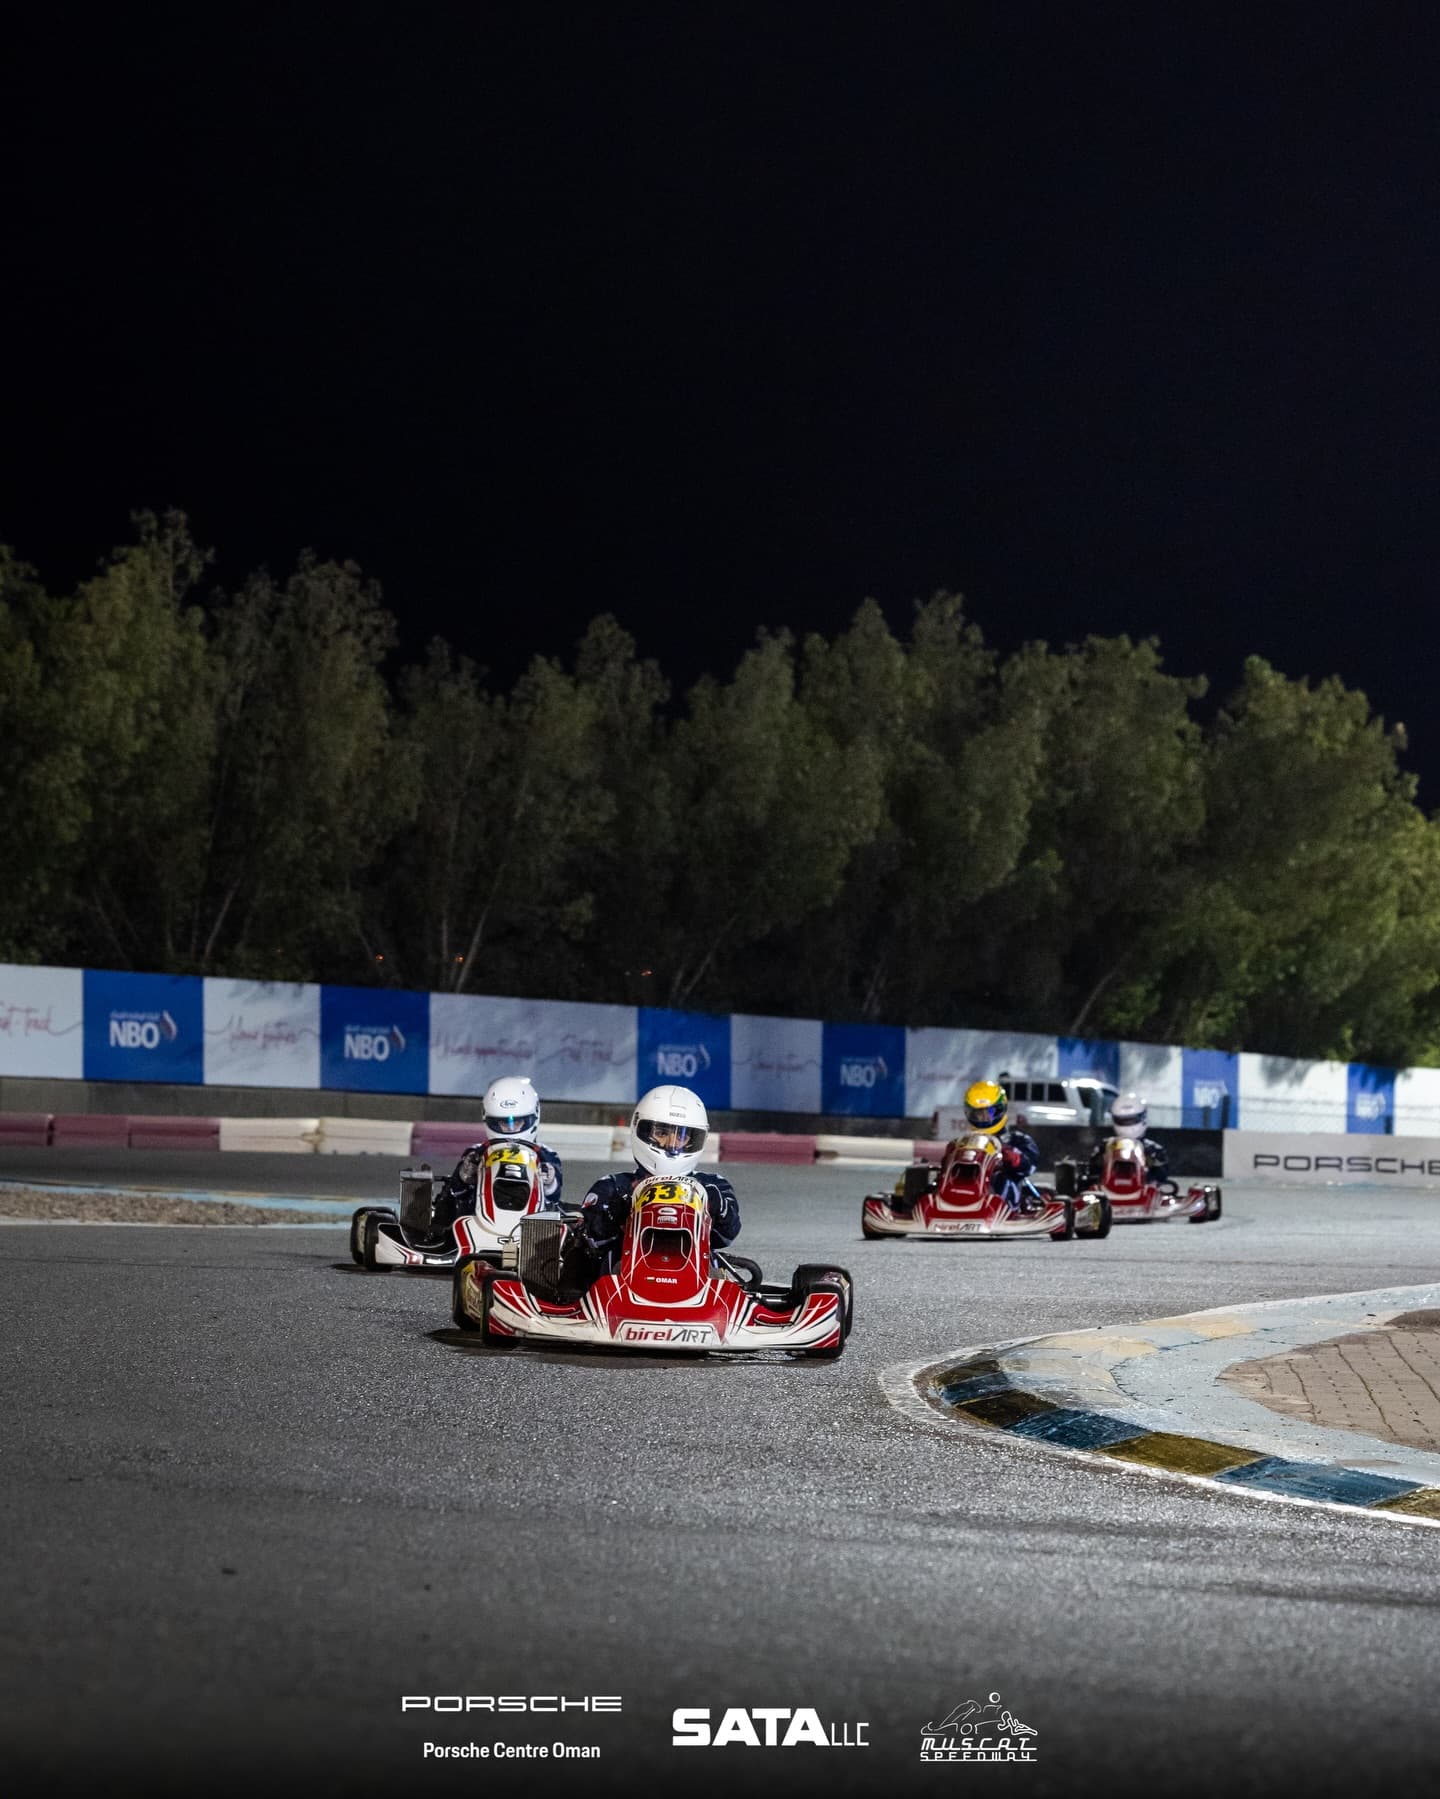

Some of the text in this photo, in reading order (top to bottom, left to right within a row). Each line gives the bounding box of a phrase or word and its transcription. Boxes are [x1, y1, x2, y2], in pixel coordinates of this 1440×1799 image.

[109, 1020, 160, 1049] NBO
[343, 1034, 390, 1062] NBO
[656, 1052, 697, 1078] NBO
[839, 1064, 876, 1087] NBO
[625, 1327, 712, 1344] birelART
